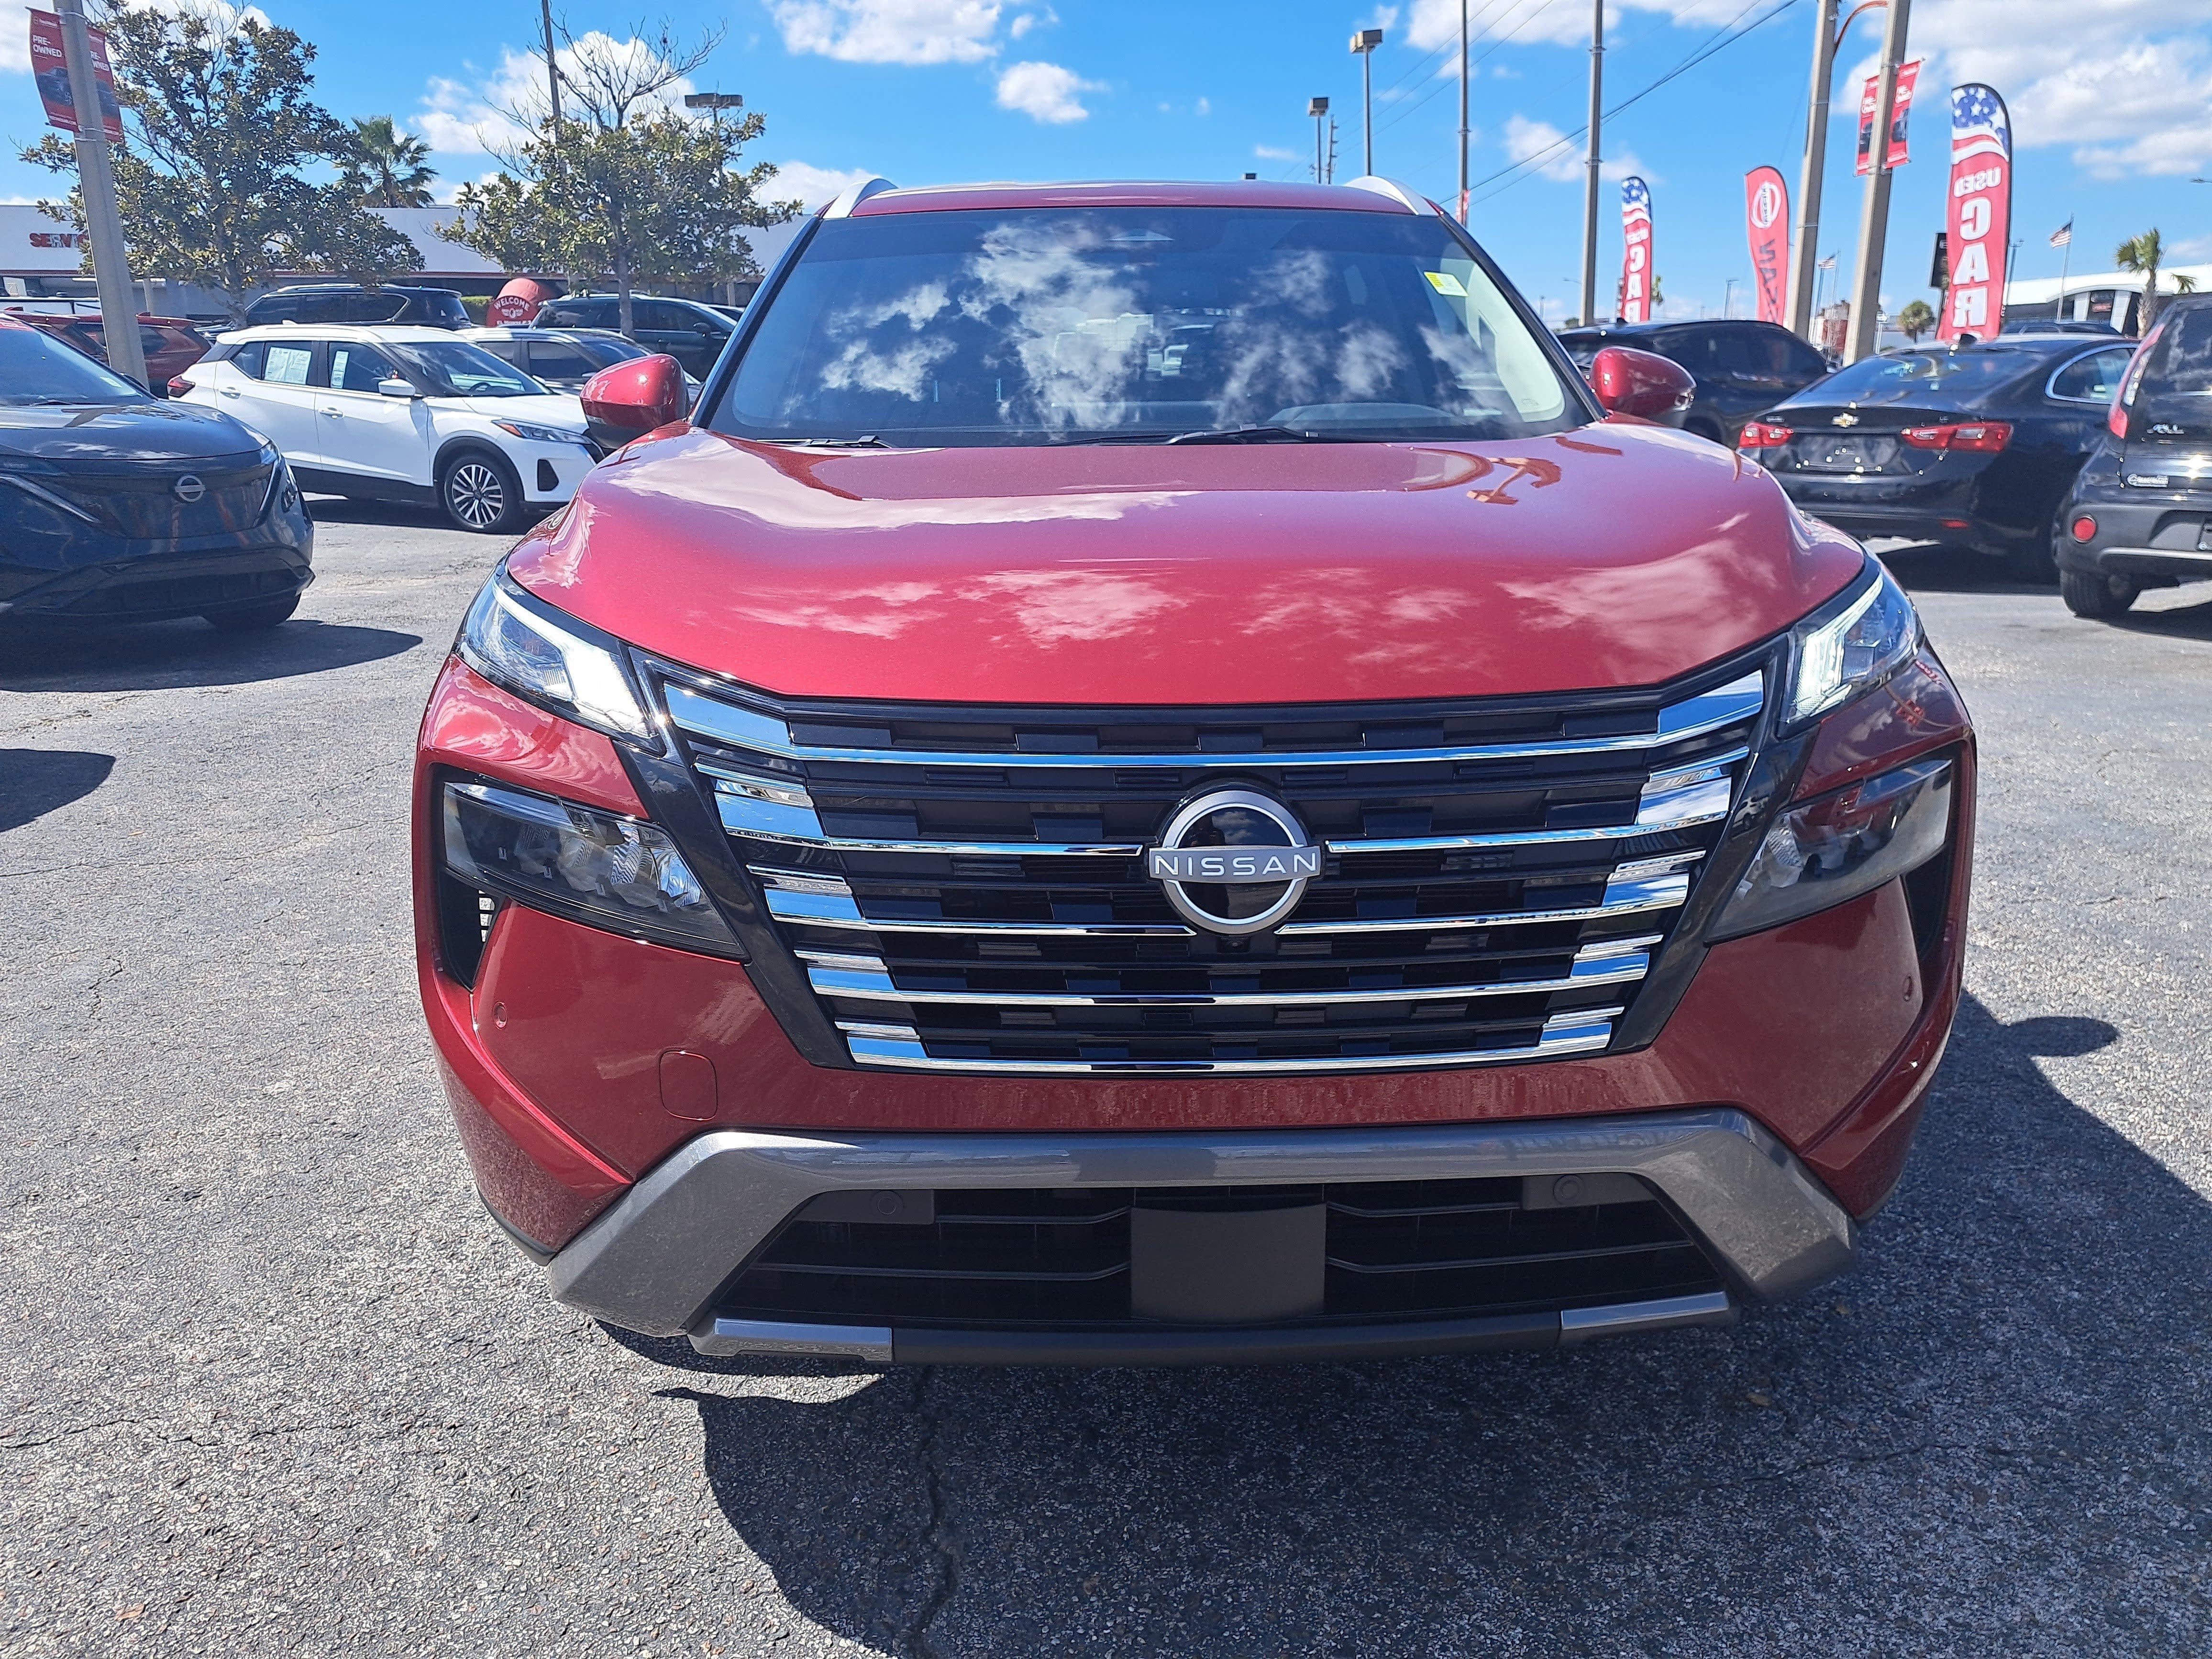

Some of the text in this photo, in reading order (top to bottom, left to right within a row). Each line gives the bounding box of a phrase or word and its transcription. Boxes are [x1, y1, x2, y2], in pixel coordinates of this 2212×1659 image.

[32, 34, 51, 46] PRE-
[33, 44, 63, 58] OWNED
[89, 50, 101, 61] RE-
[91, 59, 110, 72] WNED
[493, 296, 531, 312] WELCOME
[1153, 852, 1316, 876] NISSAN
